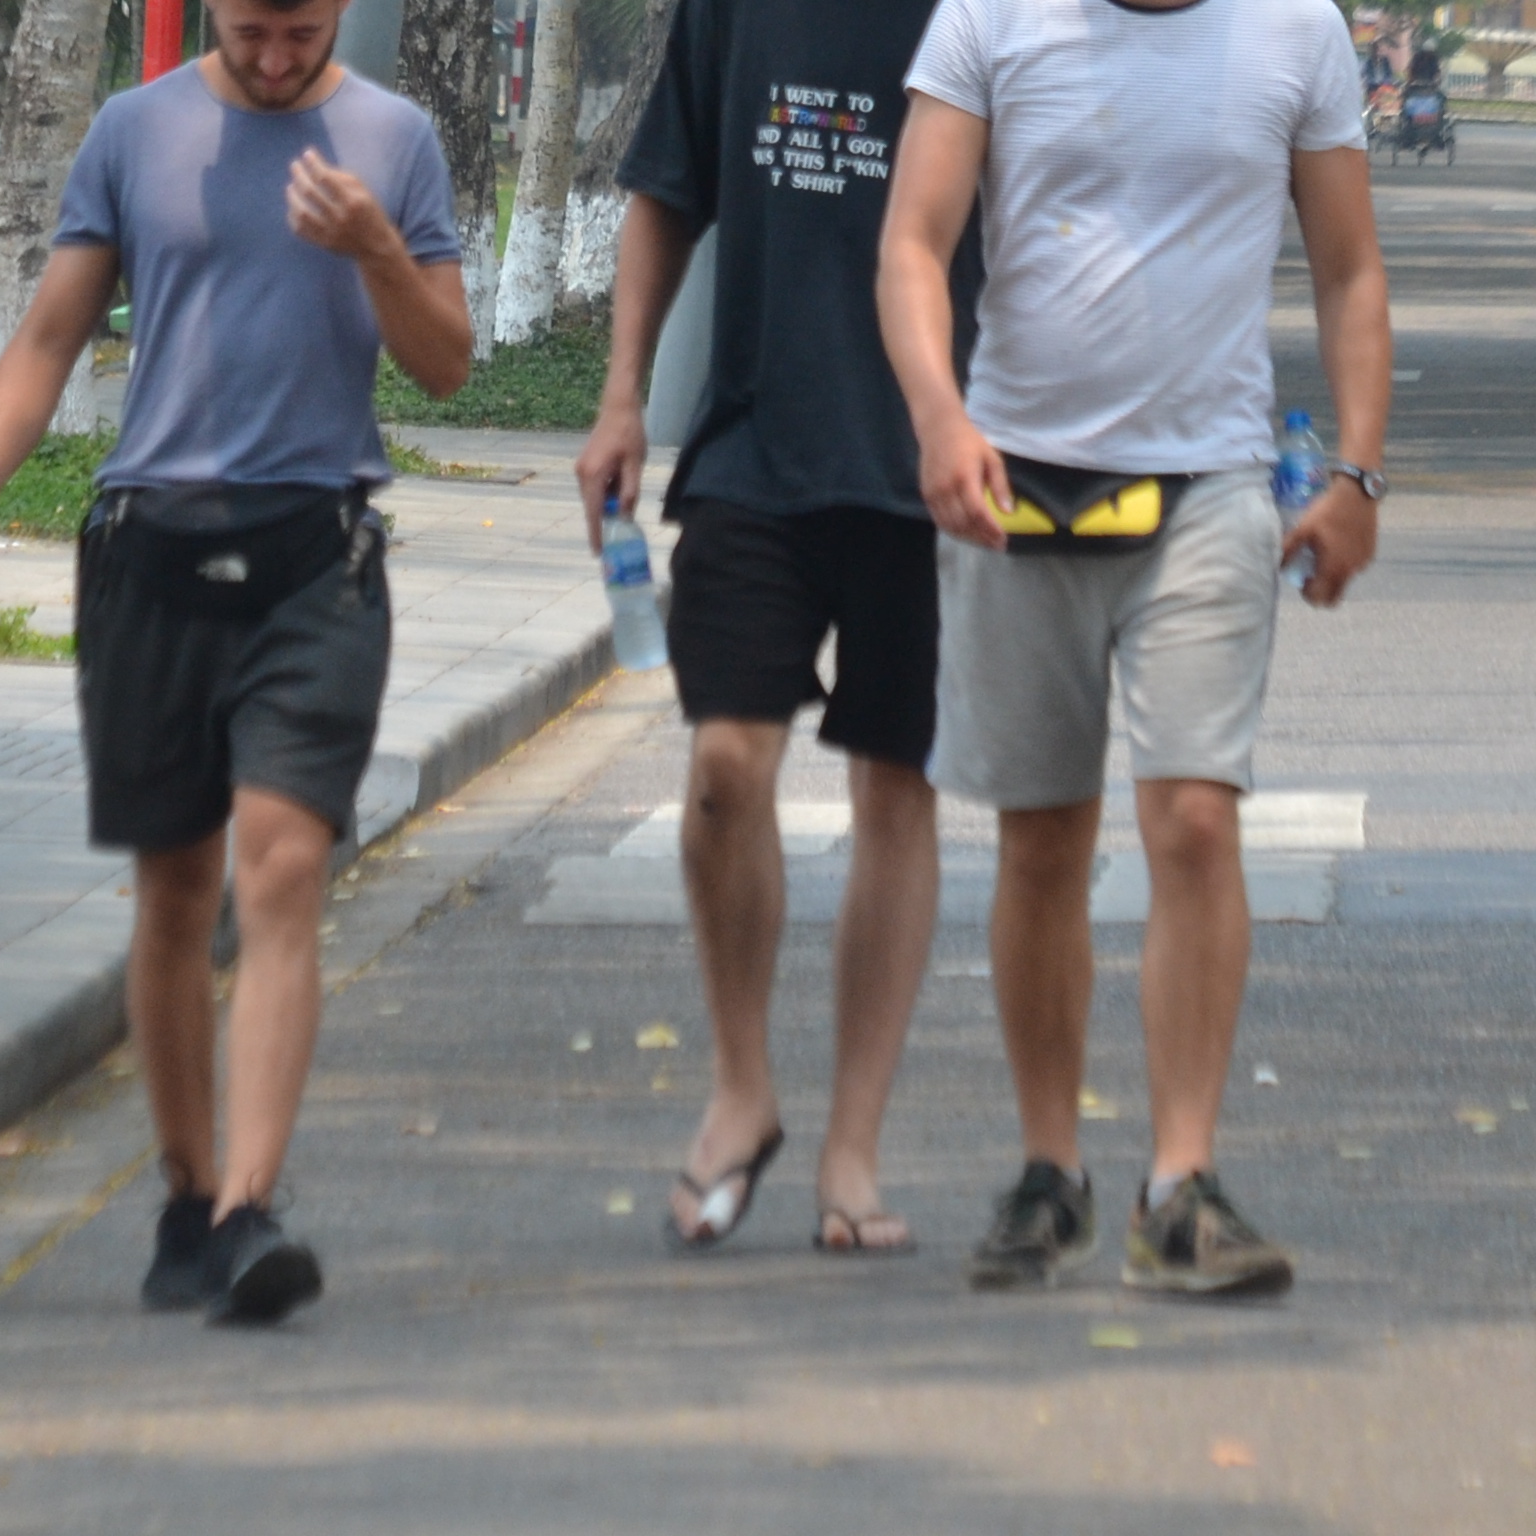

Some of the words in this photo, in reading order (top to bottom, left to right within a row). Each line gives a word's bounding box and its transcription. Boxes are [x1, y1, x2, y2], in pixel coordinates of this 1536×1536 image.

[770, 84, 779, 102] I
[785, 85, 838, 108] WENT
[848, 93, 875, 113] TO
[789, 129, 823, 149] ALL
[831, 133, 840, 151] I
[848, 135, 888, 158] GOT
[784, 148, 825, 171] THIS
[771, 168, 783, 187] T
[791, 172, 846, 195] SHIRT
